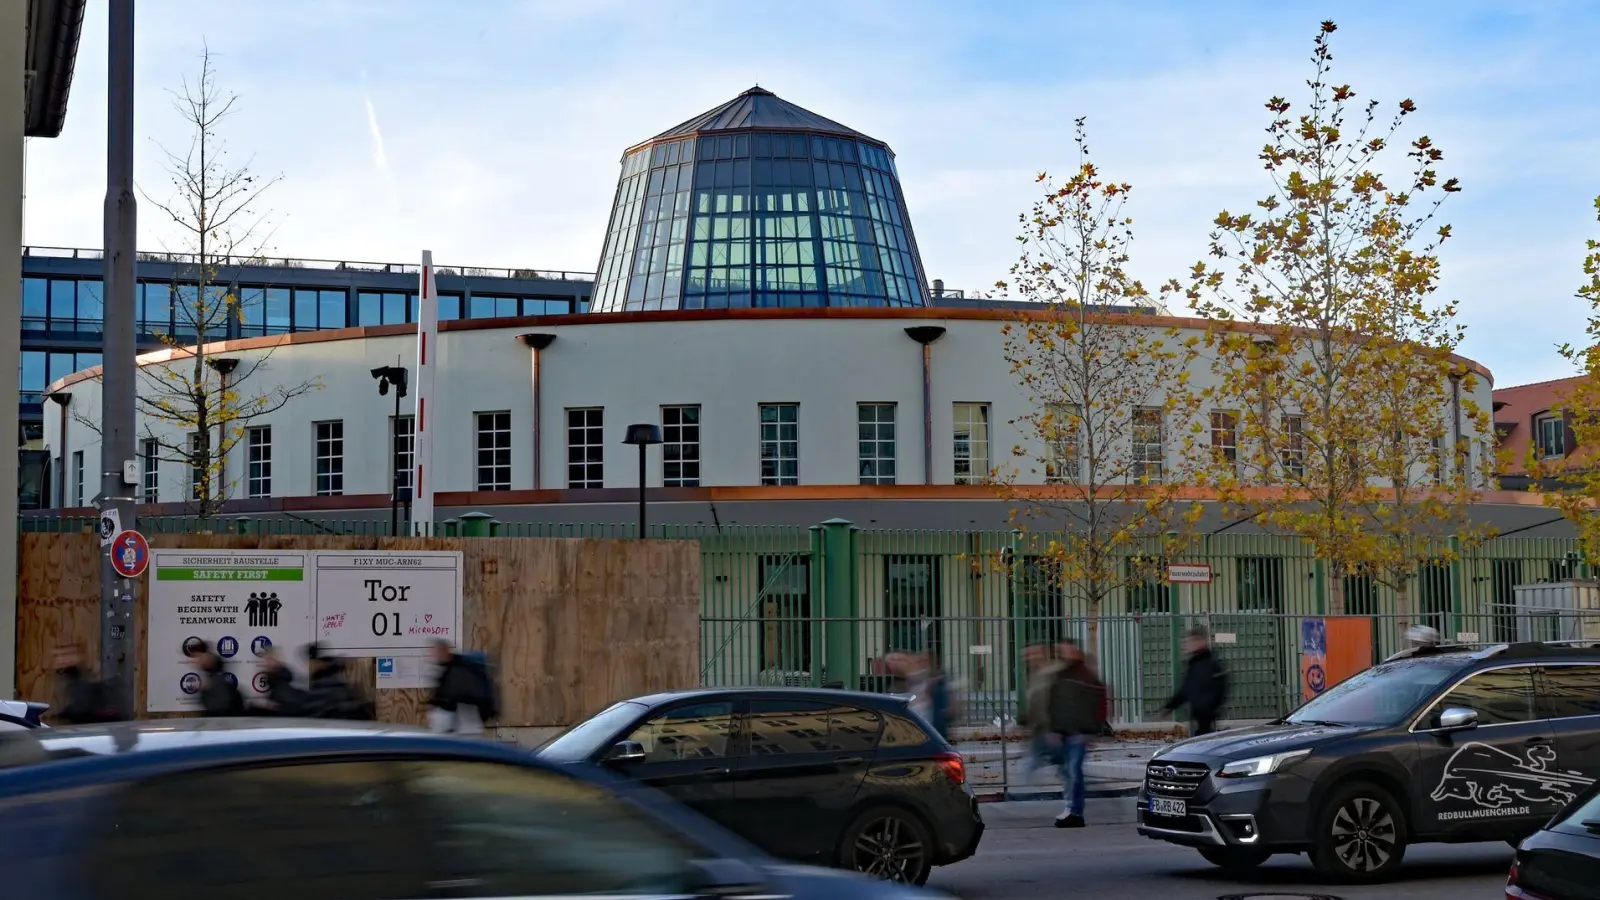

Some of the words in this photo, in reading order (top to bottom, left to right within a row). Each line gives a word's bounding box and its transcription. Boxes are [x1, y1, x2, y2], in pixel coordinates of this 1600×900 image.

[183, 557, 231, 565] SICHERHEIT
[233, 557, 279, 565] BAUSTELLE
[193, 570, 234, 579] SAFETY
[237, 570, 268, 579] FIRST
[364, 579, 411, 601] Tor
[371, 612, 403, 636] 01
[1173, 801, 1185, 814] 422
[1438, 806, 1530, 820] REDBULLMUENCHEN.DE
